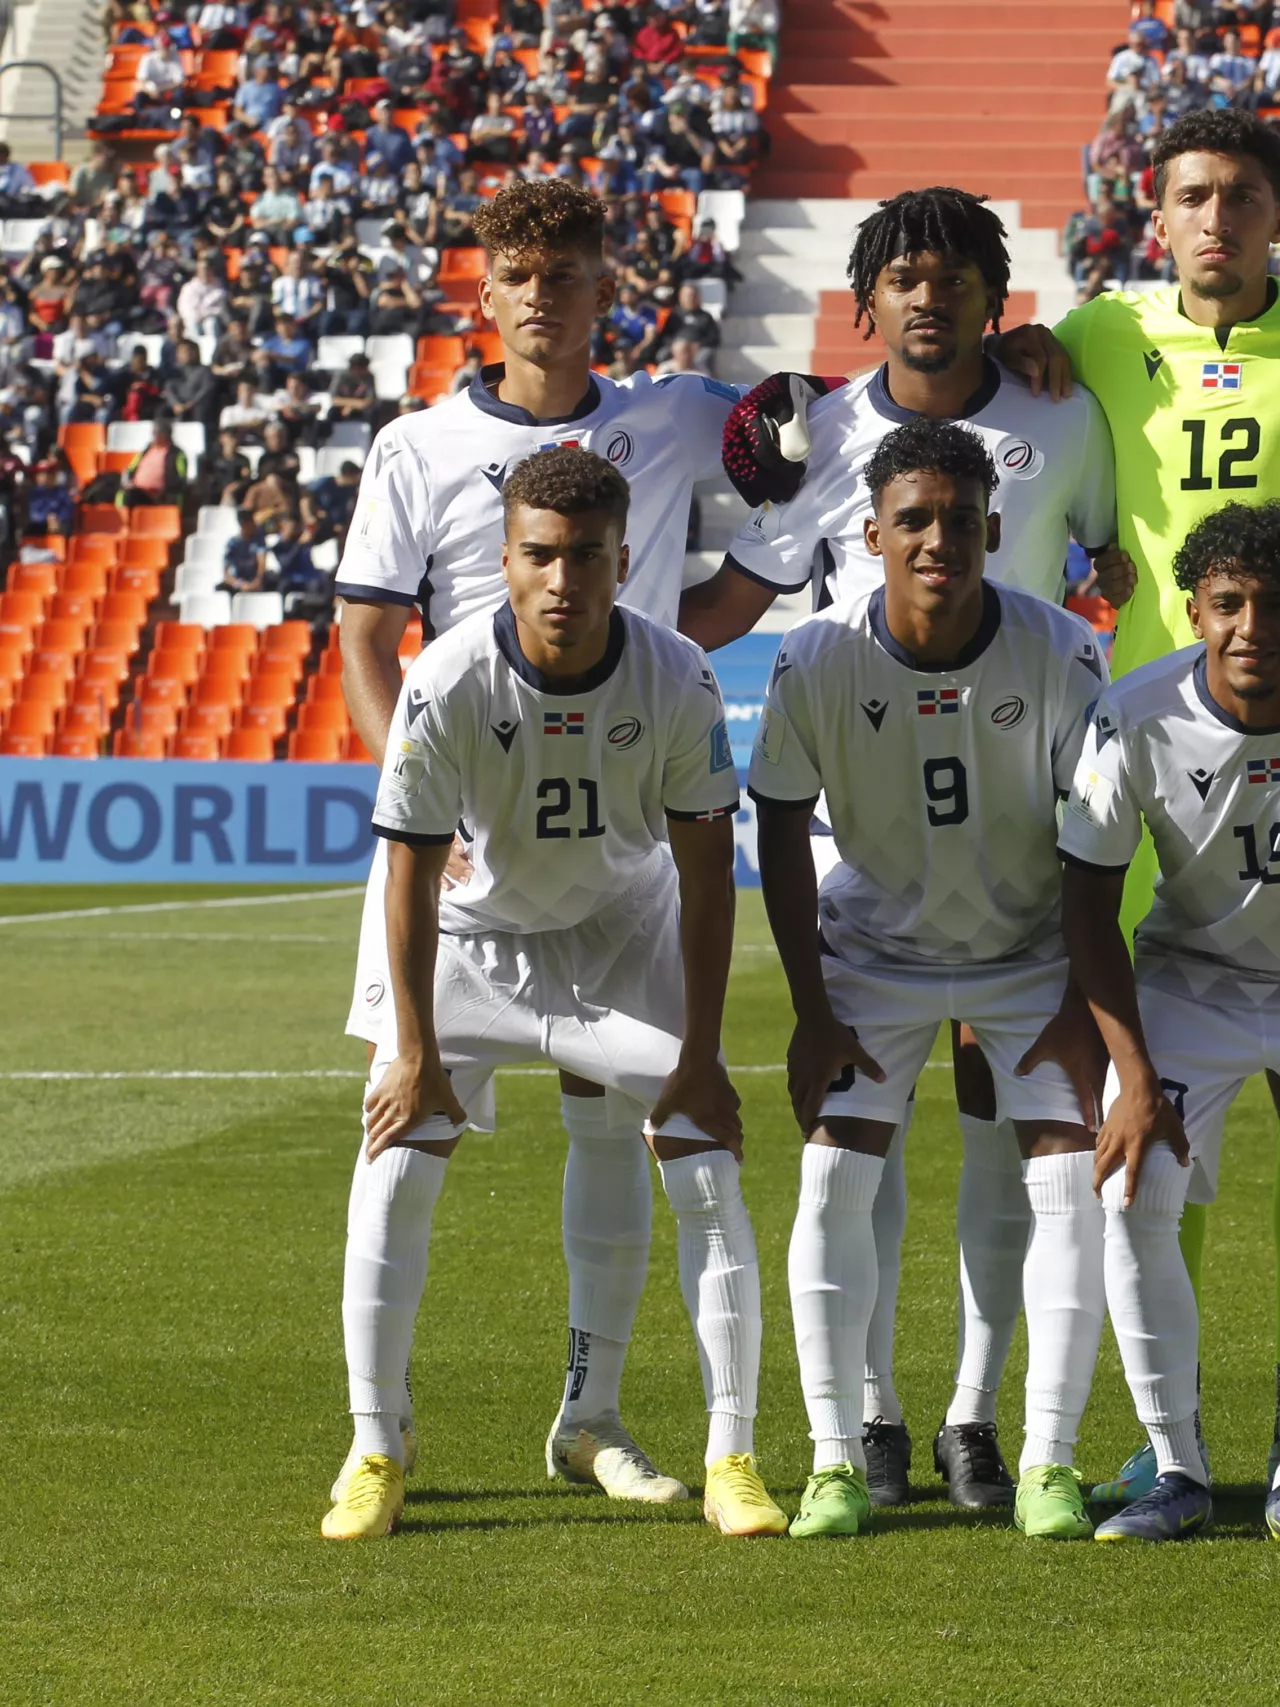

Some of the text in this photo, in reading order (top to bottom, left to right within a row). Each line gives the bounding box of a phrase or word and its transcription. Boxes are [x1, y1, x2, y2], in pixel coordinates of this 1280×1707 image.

[1180, 417, 1261, 491] 12
[0, 780, 378, 866] WORLD
[535, 776, 606, 840] 21
[922, 755, 970, 828] 9
